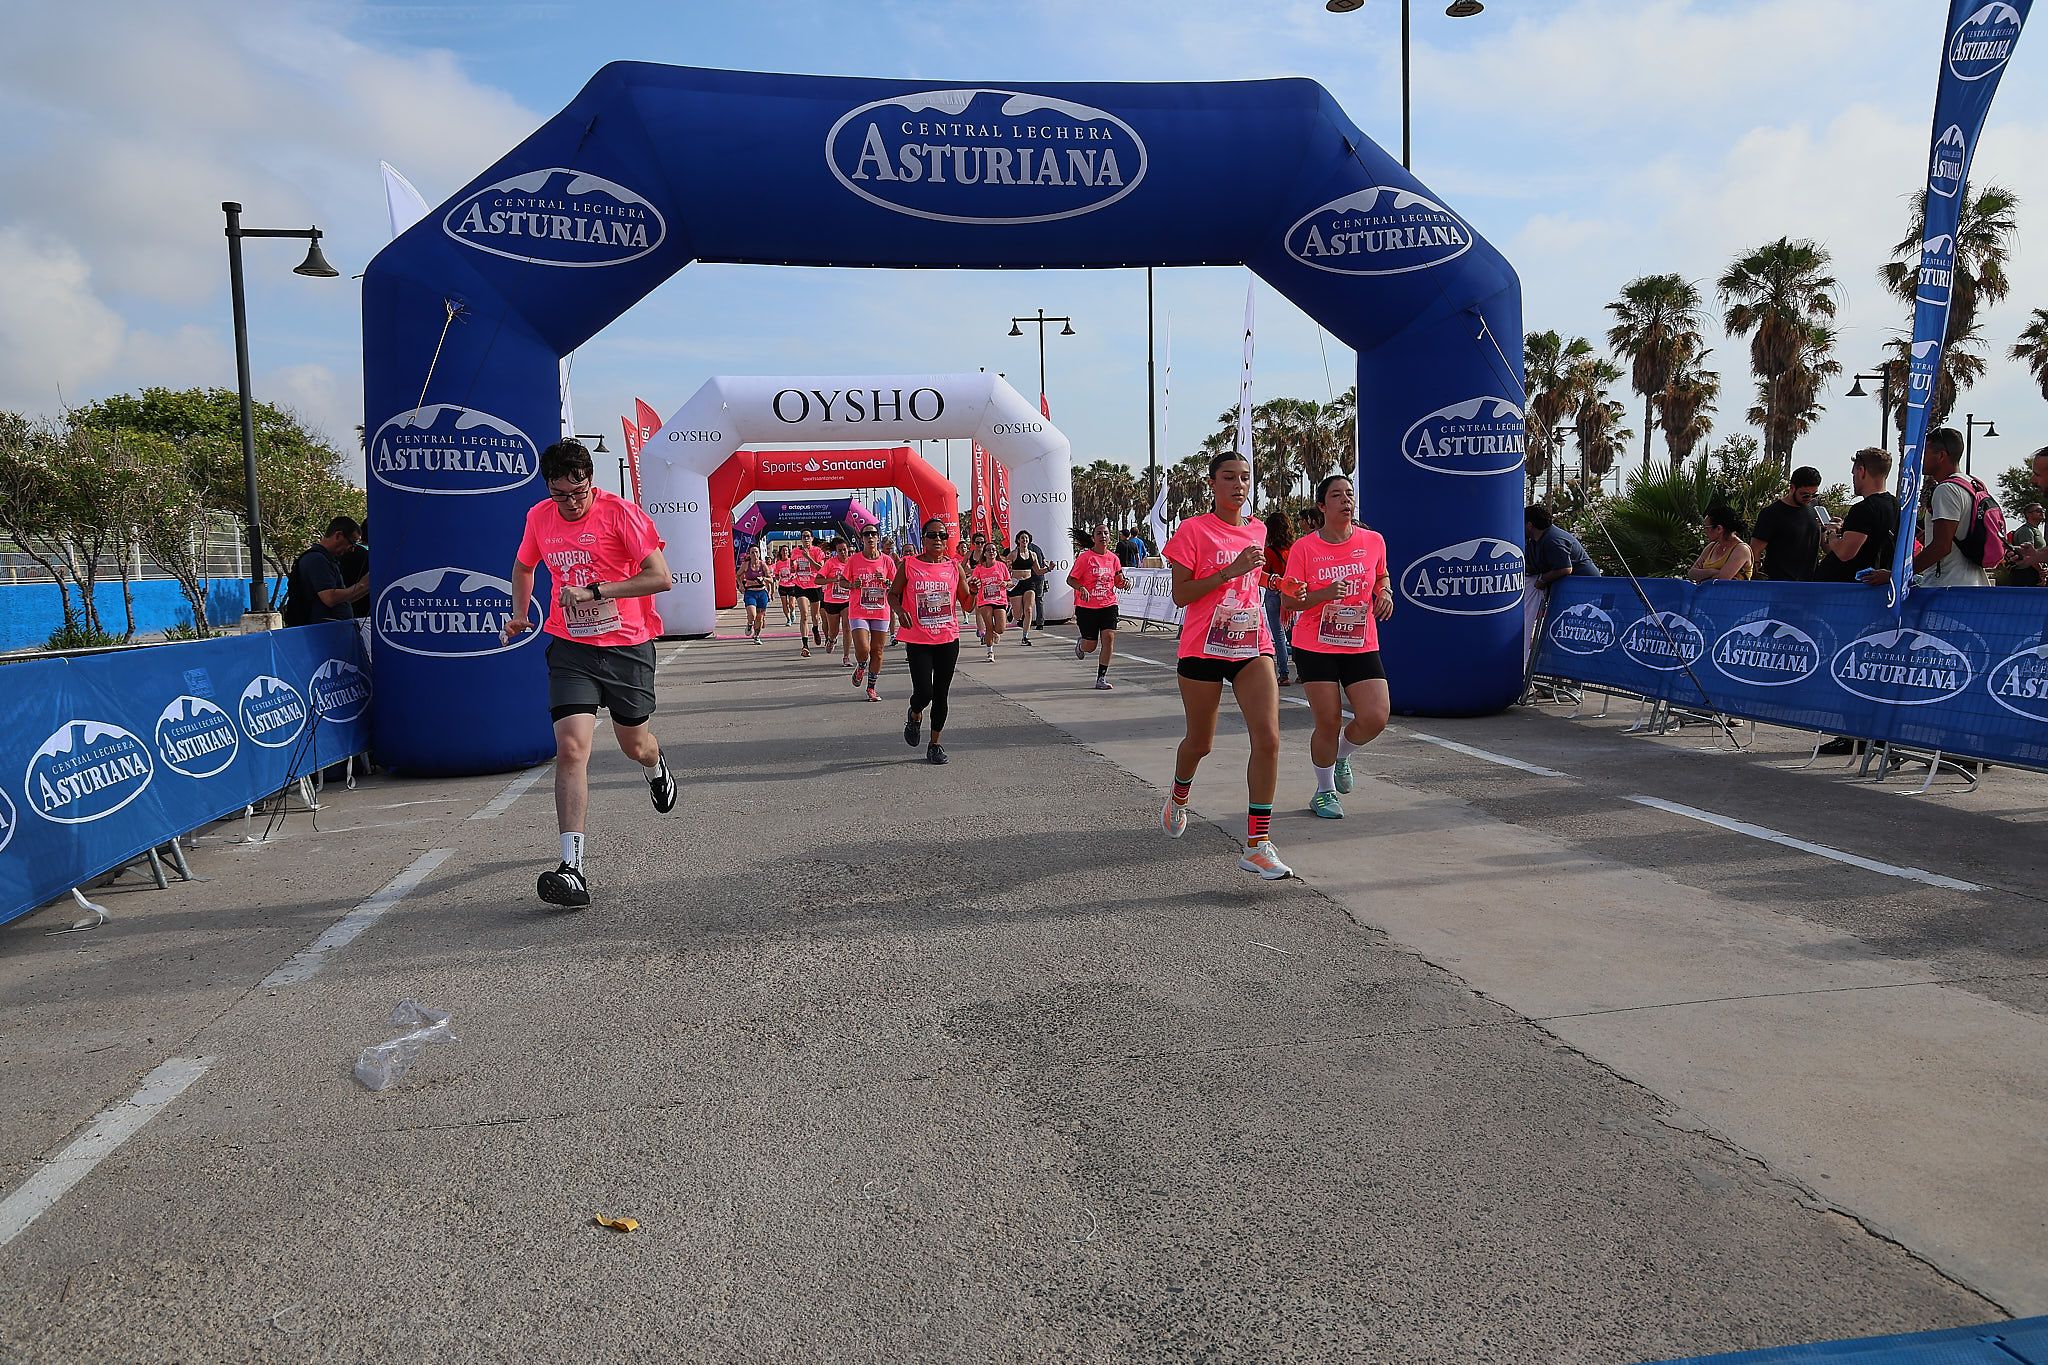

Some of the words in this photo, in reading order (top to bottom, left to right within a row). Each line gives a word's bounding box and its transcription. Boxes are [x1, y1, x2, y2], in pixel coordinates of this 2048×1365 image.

[1952, 32, 2011, 61] ASTURIANA
[902, 121, 1002, 138] CENTRAL
[1012, 125, 1113, 140] LECHERA
[851, 122, 1124, 187] ASTURIANA
[494, 198, 565, 210] CENTRAL
[573, 202, 645, 219] LECHERA
[456, 202, 649, 248] ASTURIANA
[1332, 215, 1396, 230] CENTRAL
[1401, 213, 1452, 223] LECHERA
[1300, 224, 1466, 257] ASTURIANA
[1917, 267, 1951, 288] STURI
[772, 387, 946, 424] OYSHO
[668, 430, 722, 442] OYSHO
[992, 422, 1043, 436] OYSHO
[1440, 424, 1493, 434] CENTRAL
[396, 434, 455, 444] CENTRAL
[462, 436, 523, 449] LECHERA
[377, 438, 530, 475] ASTURIANA
[762, 460, 803, 475] Sports
[822, 458, 886, 472] Santander
[1021, 492, 1067, 504] OYSHO
[650, 501, 698, 514] OYSHO
[671, 572, 702, 584] SHO
[1438, 565, 1490, 574] CENTRAL
[915, 581, 949, 591] CARRERA
[1412, 568, 1525, 597] ASTURIANA
[401, 598, 459, 607] CENTRAL
[466, 598, 512, 608] LECHE
[382, 599, 533, 634] ASTURIAN
[578, 607, 600, 618] 016
[1227, 631, 1246, 640] 016
[1335, 623, 1354, 631] 016
[1736, 639, 1770, 649] CENTRAL
[1772, 641, 1810, 653] LECHERA
[1717, 639, 1808, 673] ASTURIANA
[1863, 651, 1906, 663] CENTRAL
[1910, 654, 1958, 667] LECHERA
[1838, 651, 1958, 690] ASTURIANA
[171, 723, 199, 737] CENTRAL
[163, 725, 236, 764] ASTURIANA
[51, 753, 92, 775] CENTRAL
[93, 740, 135, 759] LECHERA
[39, 752, 149, 812] ASTURIANA
